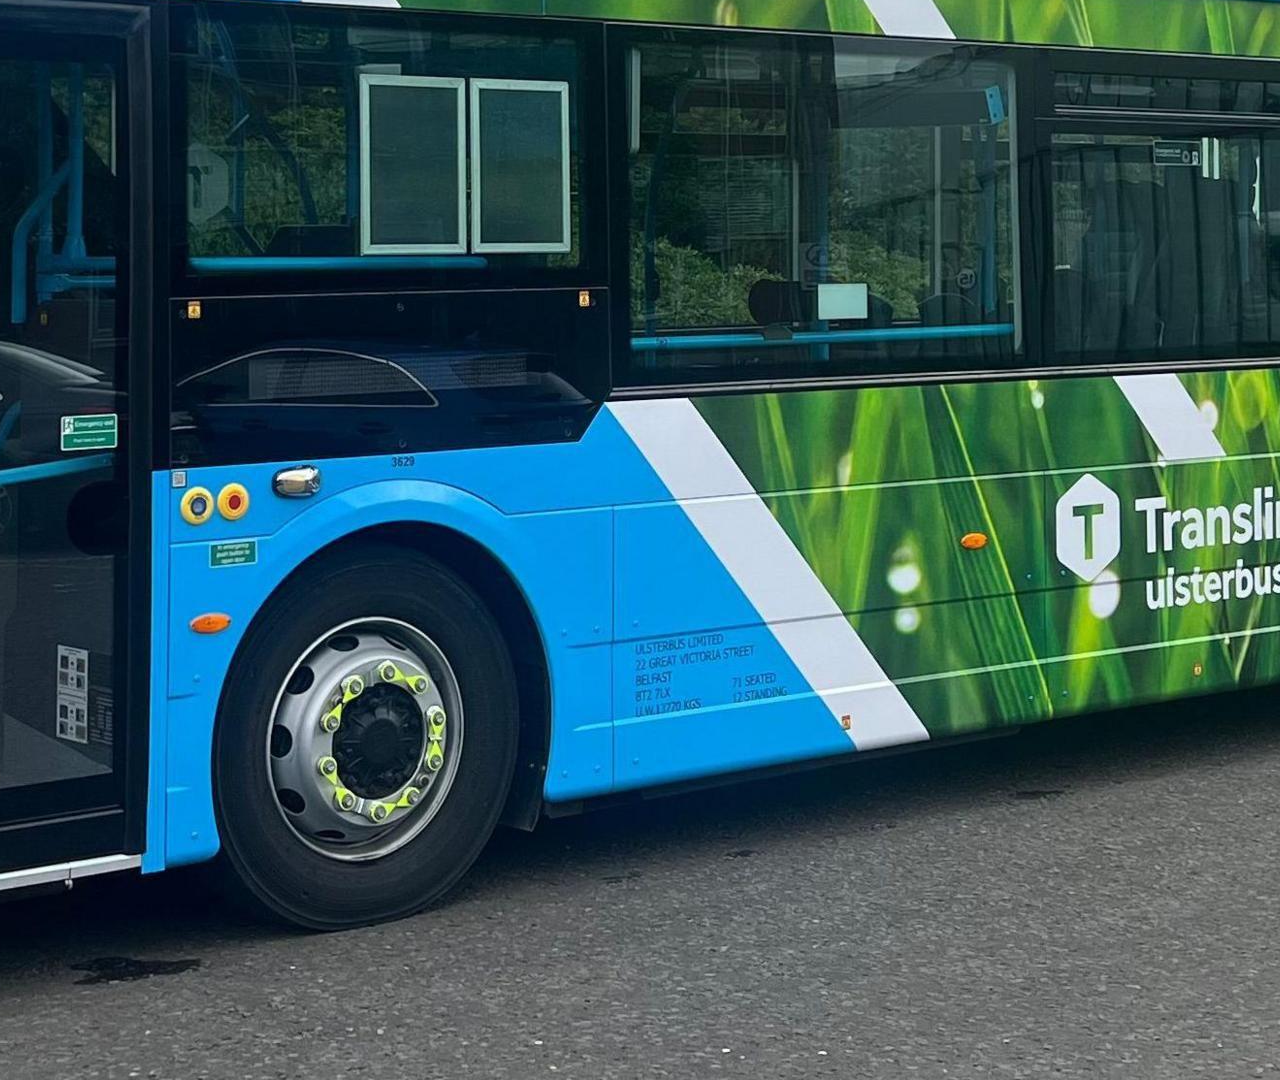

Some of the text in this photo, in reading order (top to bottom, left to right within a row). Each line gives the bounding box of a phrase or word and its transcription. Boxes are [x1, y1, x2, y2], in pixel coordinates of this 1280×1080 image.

[635, 633, 724, 655] ULSTERBUS LIMITED
[635, 645, 755, 671] 22 GREAT VICTORIA STREET
[635, 671, 672, 686] BELFAST
[744, 672, 777, 687] SEATED
[744, 686, 788, 702] STANDING
